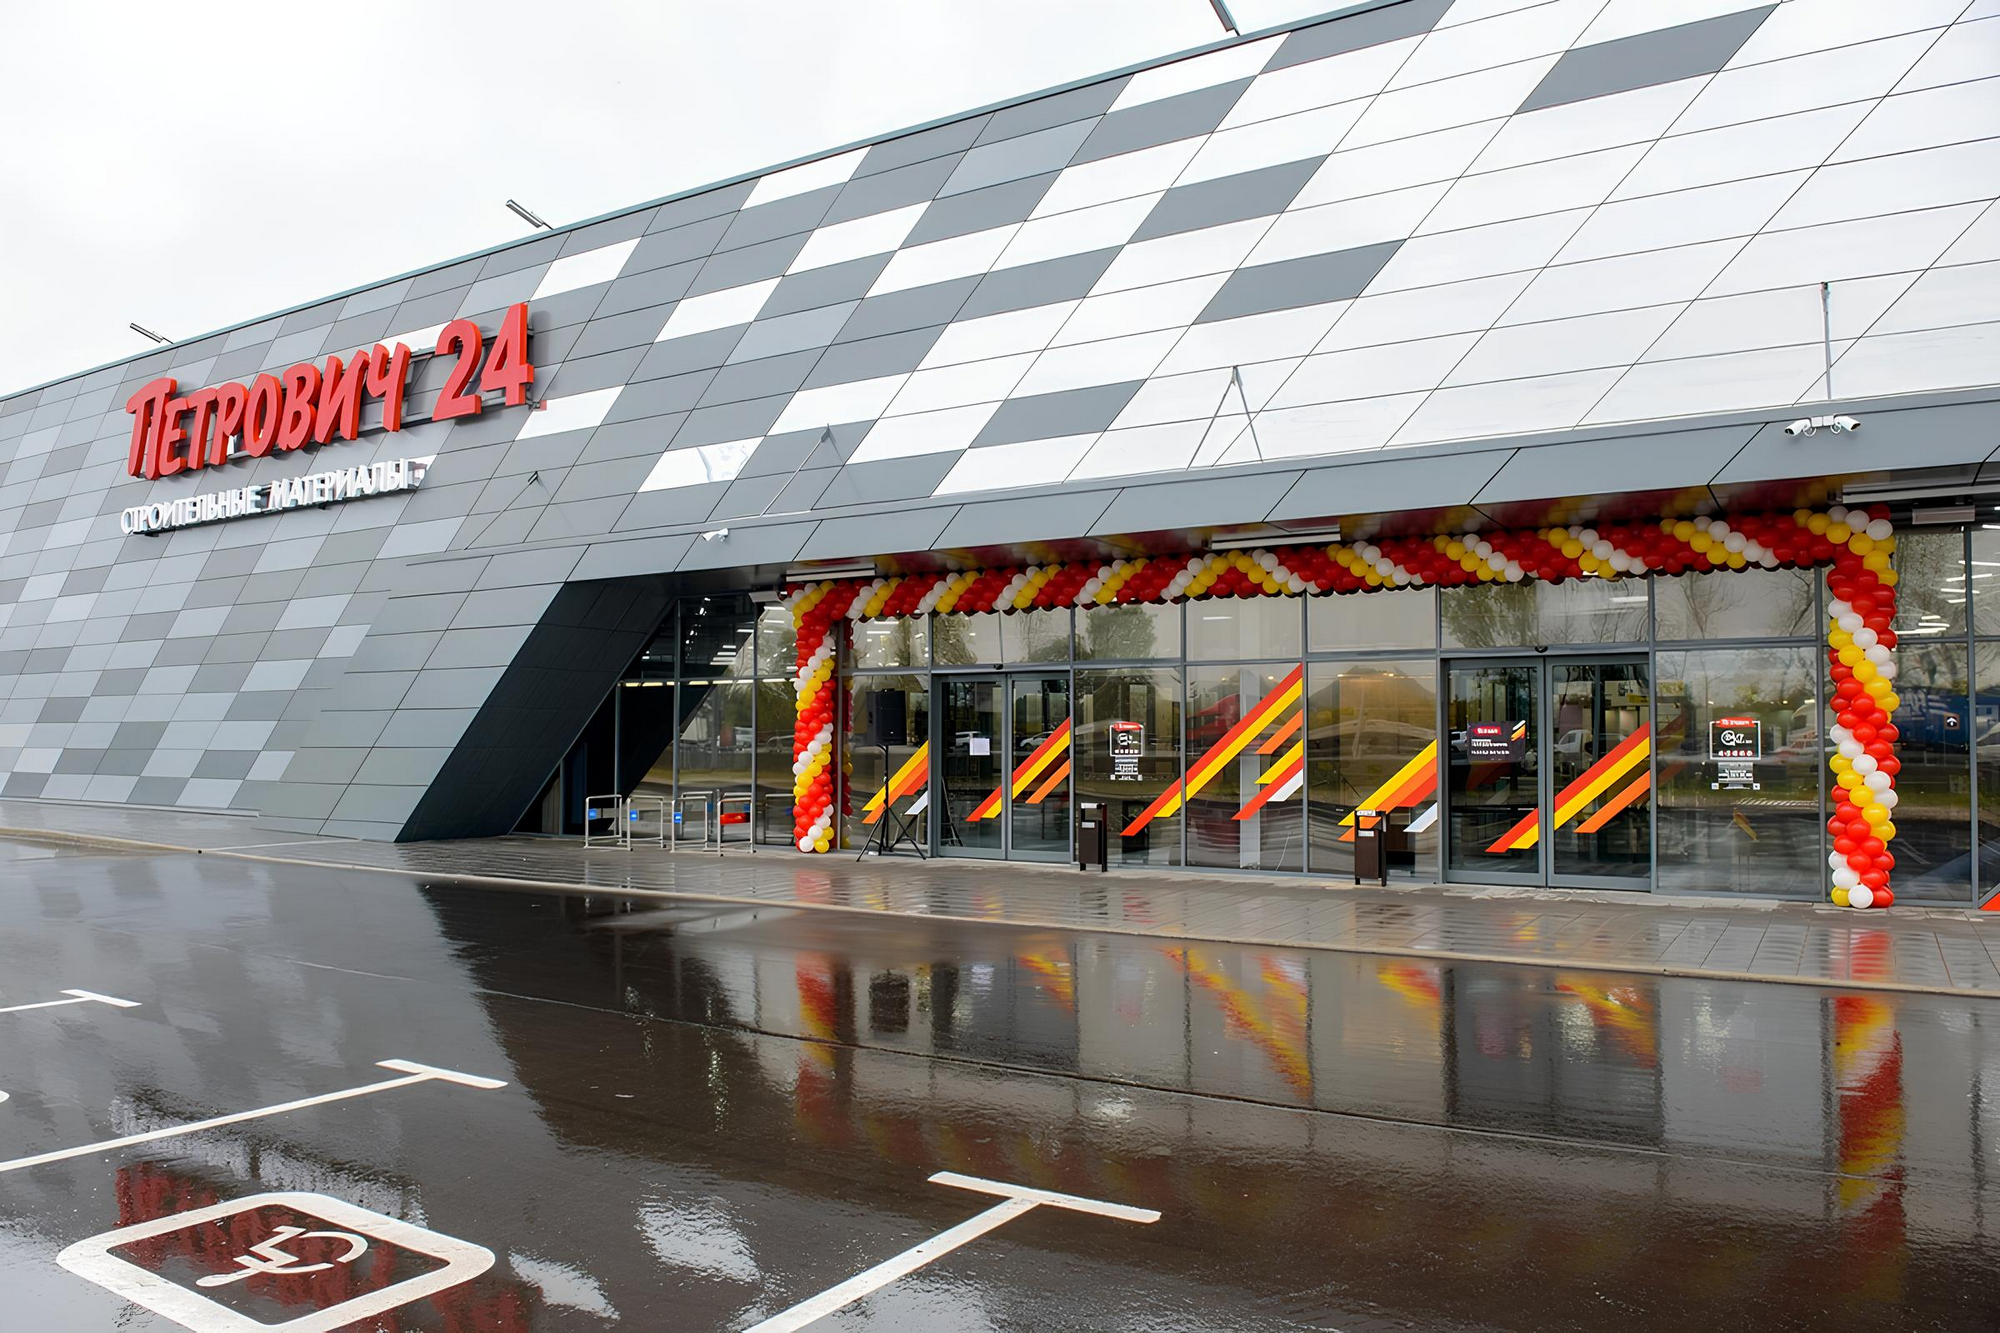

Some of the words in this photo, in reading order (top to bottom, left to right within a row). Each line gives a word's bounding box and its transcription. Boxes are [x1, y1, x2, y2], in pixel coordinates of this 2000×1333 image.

[126, 342, 411, 480] ПЕТРОВИЧ
[432, 302, 535, 422] 24
[120, 485, 262, 534] СТРОИТЕЛЬНЫЕ
[267, 458, 409, 510] МАТЕРИАЛЫ
